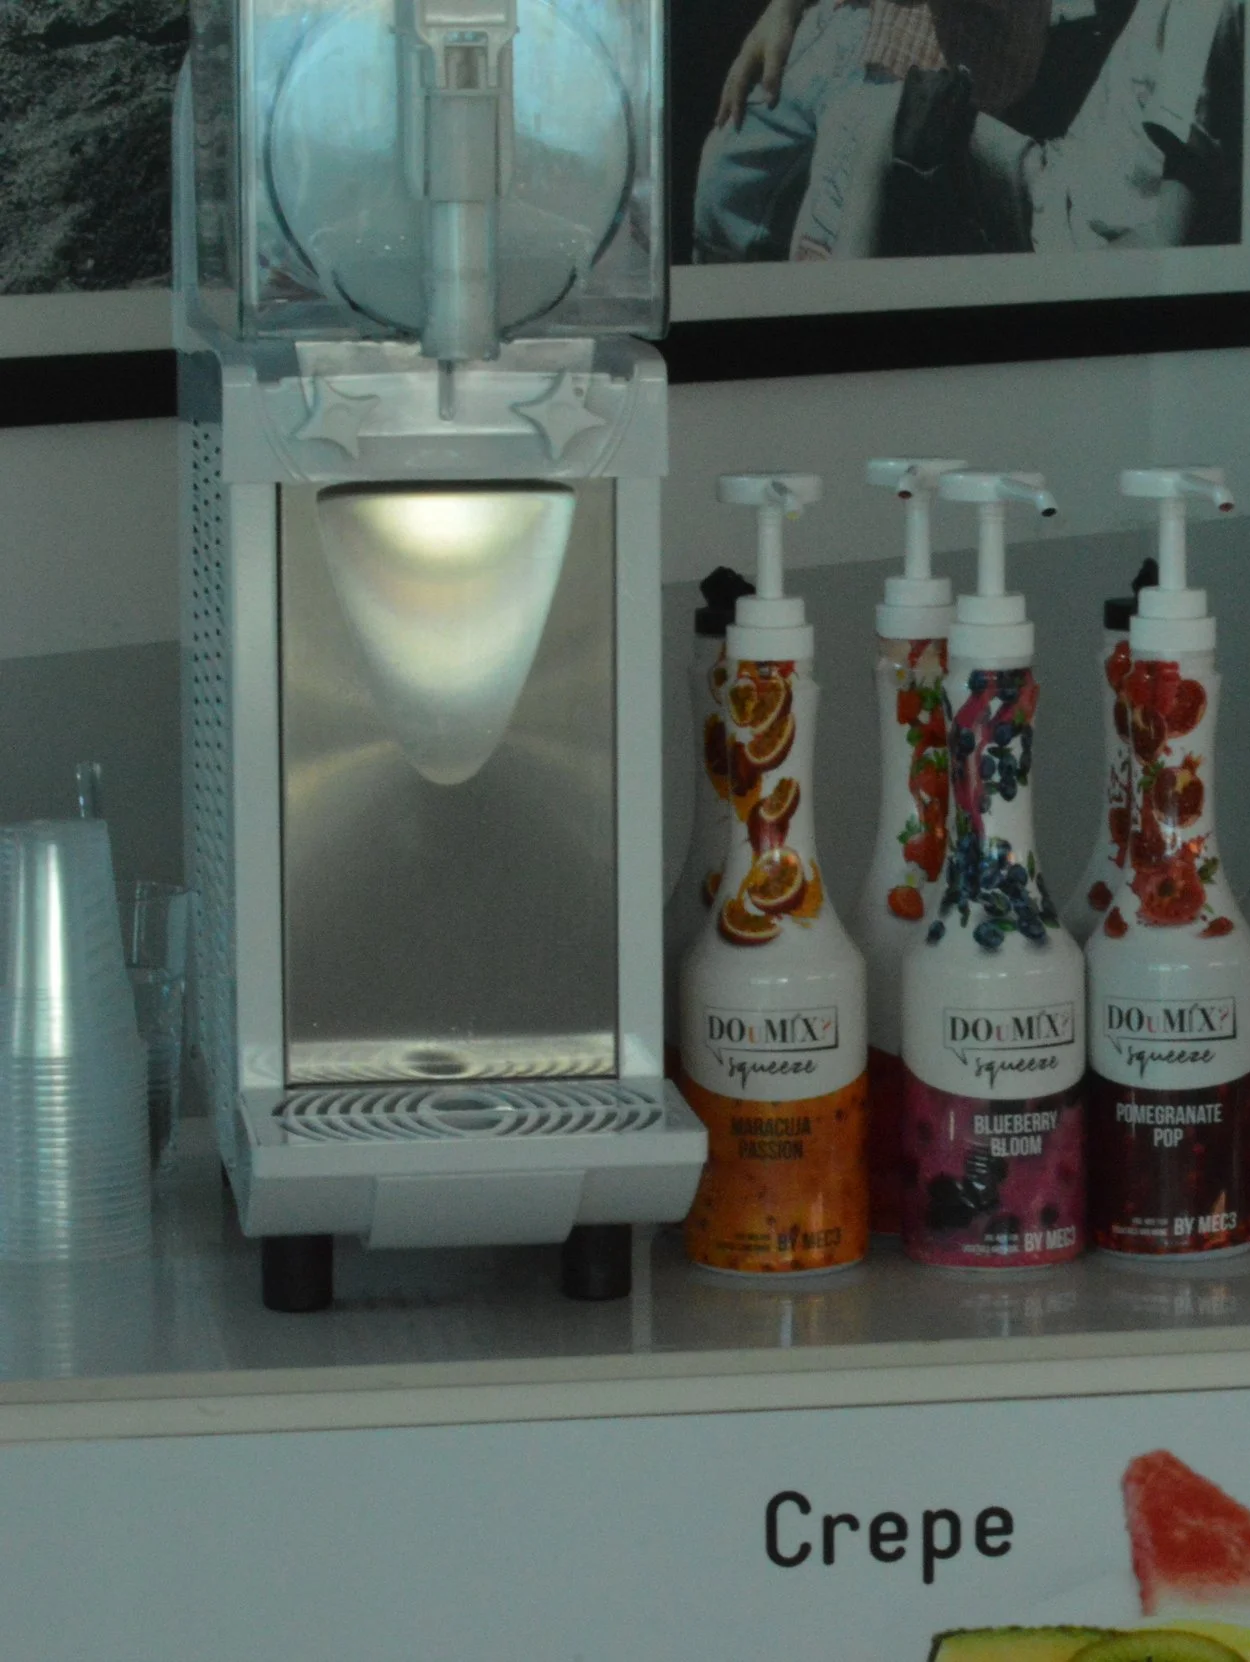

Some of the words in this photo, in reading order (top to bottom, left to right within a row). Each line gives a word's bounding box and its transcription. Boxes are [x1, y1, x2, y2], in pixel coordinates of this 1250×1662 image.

[974, 1111, 1058, 1134] BLUEBERRY
[1116, 1103, 1223, 1125] POMEGRANATE
[990, 1137, 1043, 1158] BLOOM
[1153, 1128, 1184, 1148] POP
[1173, 1217, 1196, 1237] BY
[1199, 1212, 1238, 1234] MEC3
[777, 1231, 798, 1250] BY
[1024, 1233, 1044, 1253] BY
[766, 1490, 1014, 1584] Crepe
